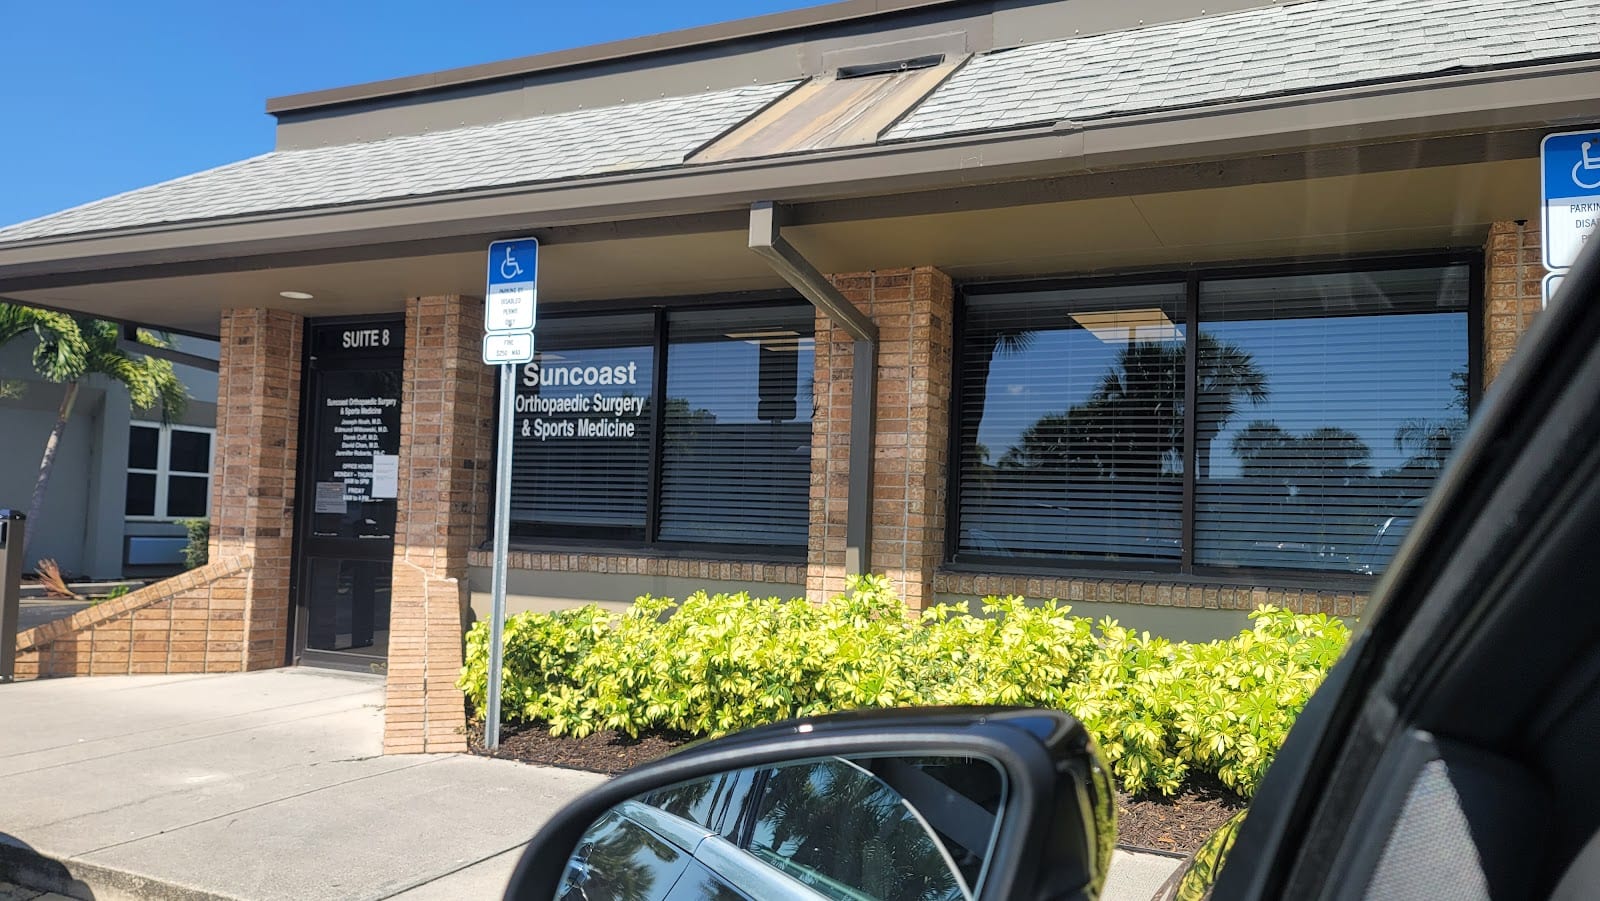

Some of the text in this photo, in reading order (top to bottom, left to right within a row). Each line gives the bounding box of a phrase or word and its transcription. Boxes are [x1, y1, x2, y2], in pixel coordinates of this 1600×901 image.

[1570, 202, 1600, 213] PARKIN
[1575, 218, 1597, 229] DISA
[342, 328, 390, 348] SUITE 8
[523, 361, 637, 387] Suncoast
[327, 398, 348, 406] Suncoast
[377, 397, 397, 407] Surgery
[515, 392, 644, 417] Orthopaedic Surgery
[344, 407, 361, 416] Sports
[361, 407, 382, 415] Medicine
[521, 418, 635, 441] & Sports Medicine
